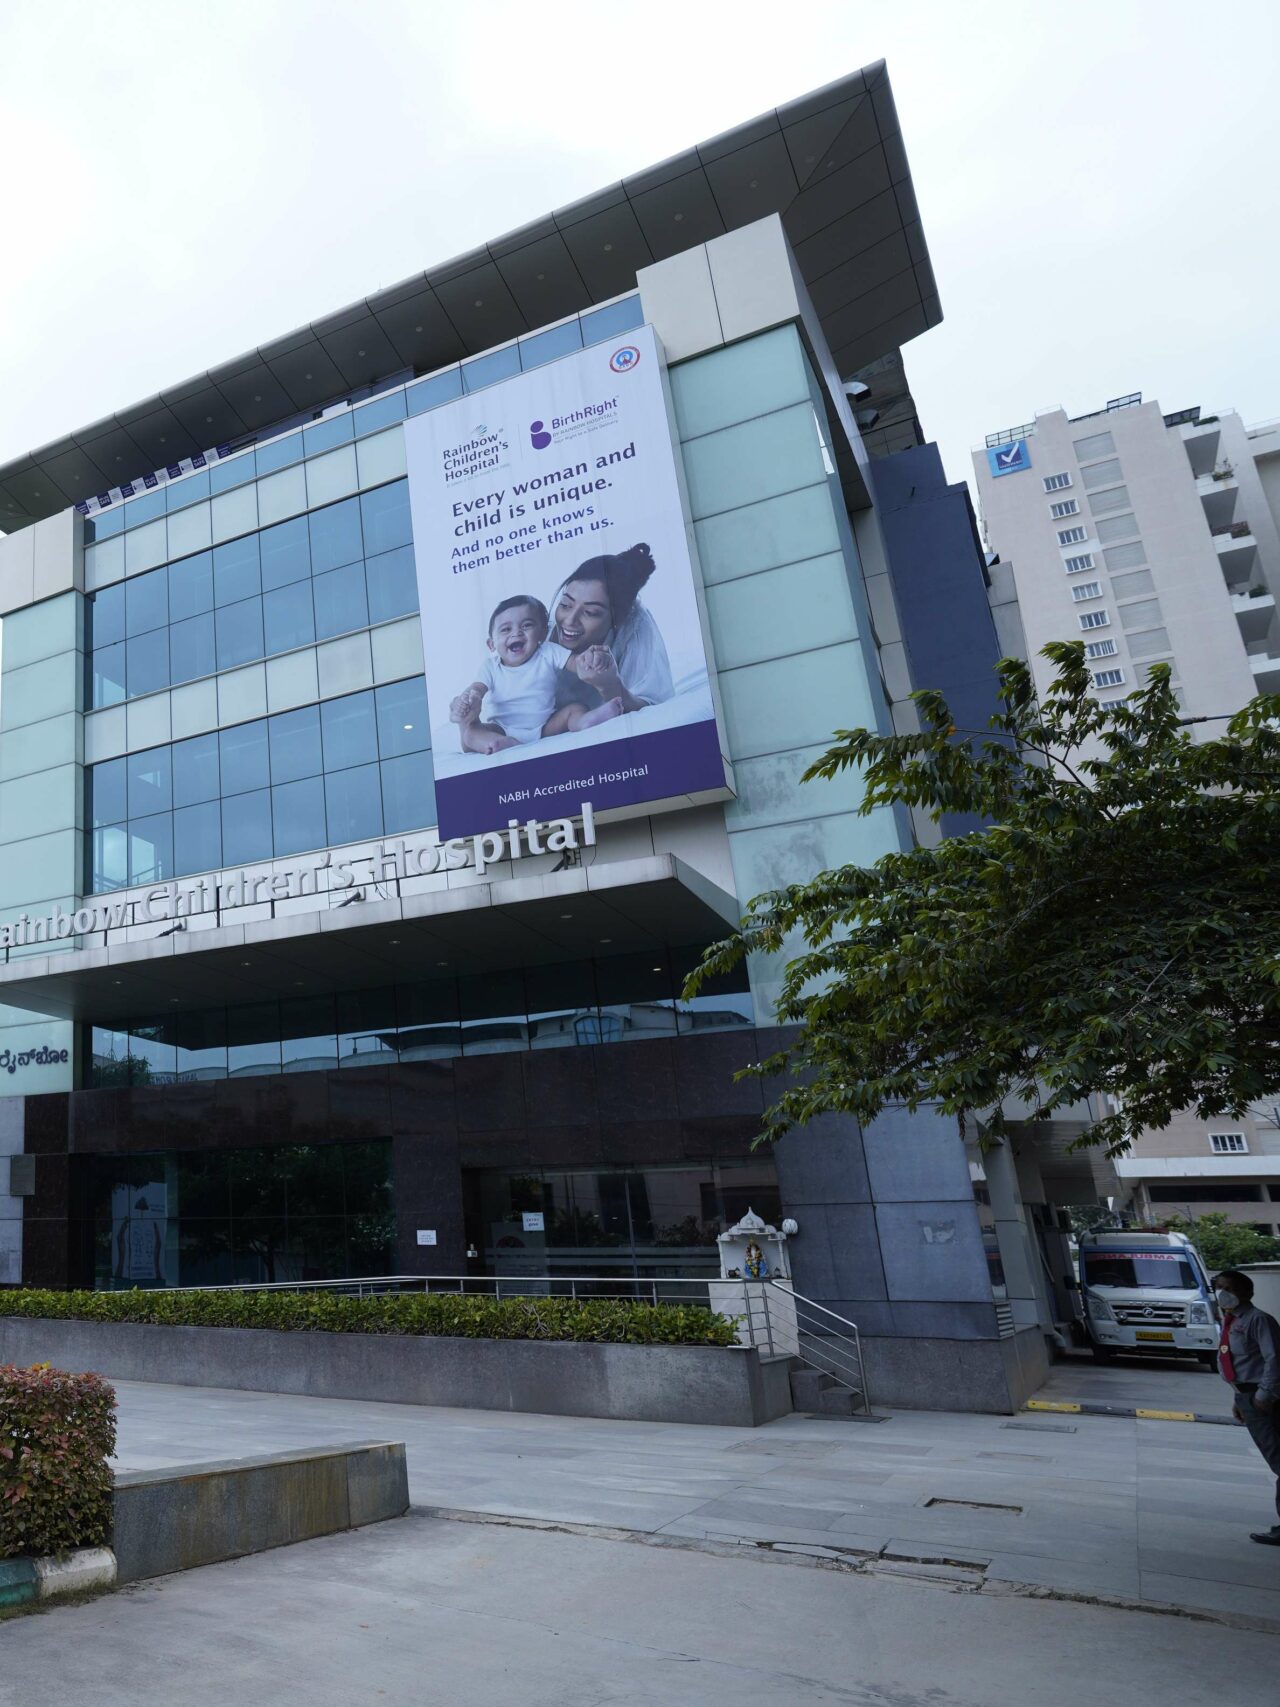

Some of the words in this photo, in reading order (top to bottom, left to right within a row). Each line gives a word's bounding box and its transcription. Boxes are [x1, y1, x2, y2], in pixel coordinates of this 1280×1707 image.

[552, 398, 617, 429] BirthRight
[443, 433, 498, 460] Rainbow
[444, 441, 509, 471] Children's
[445, 454, 499, 482] Hospital
[452, 490, 505, 517] Every
[513, 462, 588, 496] woman
[596, 442, 636, 469] and
[454, 509, 501, 537] child
[509, 504, 526, 519] is
[534, 477, 613, 511] unique.
[451, 540, 480, 560] And
[485, 535, 504, 549] no
[509, 524, 537, 540] one
[542, 505, 595, 530] knows
[452, 554, 490, 575] them
[495, 537, 543, 561] better
[548, 525, 584, 545] than
[590, 517, 614, 531] us.
[498, 790, 530, 805] NABH
[533, 775, 595, 798] Accredited
[598, 764, 649, 786] Hospital
[140, 852, 355, 922] Children's
[370, 802, 596, 881] Hospital
